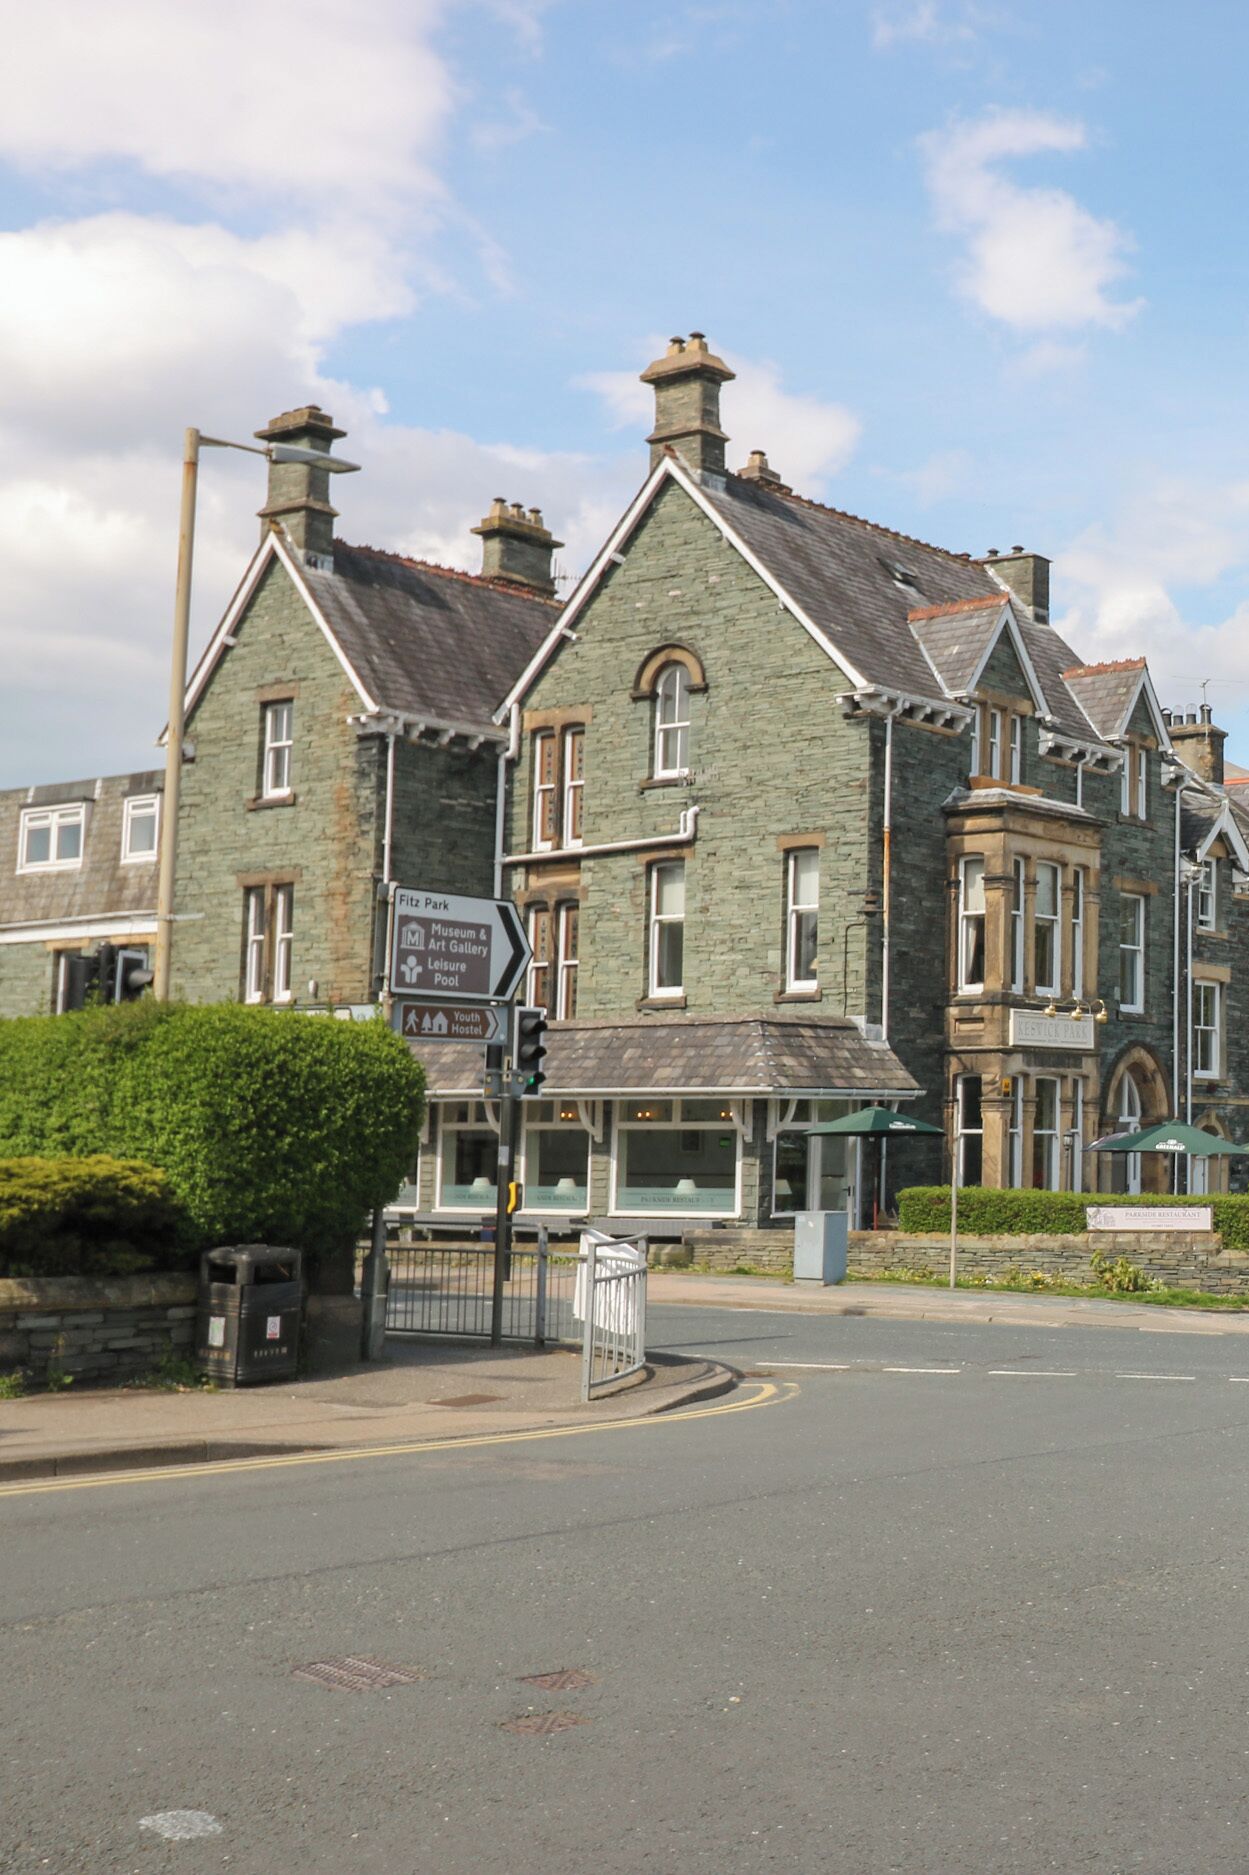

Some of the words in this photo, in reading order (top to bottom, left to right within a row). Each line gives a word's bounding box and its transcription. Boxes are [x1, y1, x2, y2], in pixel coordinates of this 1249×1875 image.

[399, 894, 420, 908] Fitz
[424, 897, 449, 911] Park
[431, 923, 476, 939] Museum
[479, 928, 487, 940] &
[428, 938, 446, 952] Art
[449, 940, 488, 958] Gallery
[428, 957, 467, 973] Leisure
[434, 973, 459, 987] Pool
[454, 1011, 480, 1022] Youth
[451, 1023, 482, 1035] Hostel
[1064, 1023, 1087, 1039] PARK
